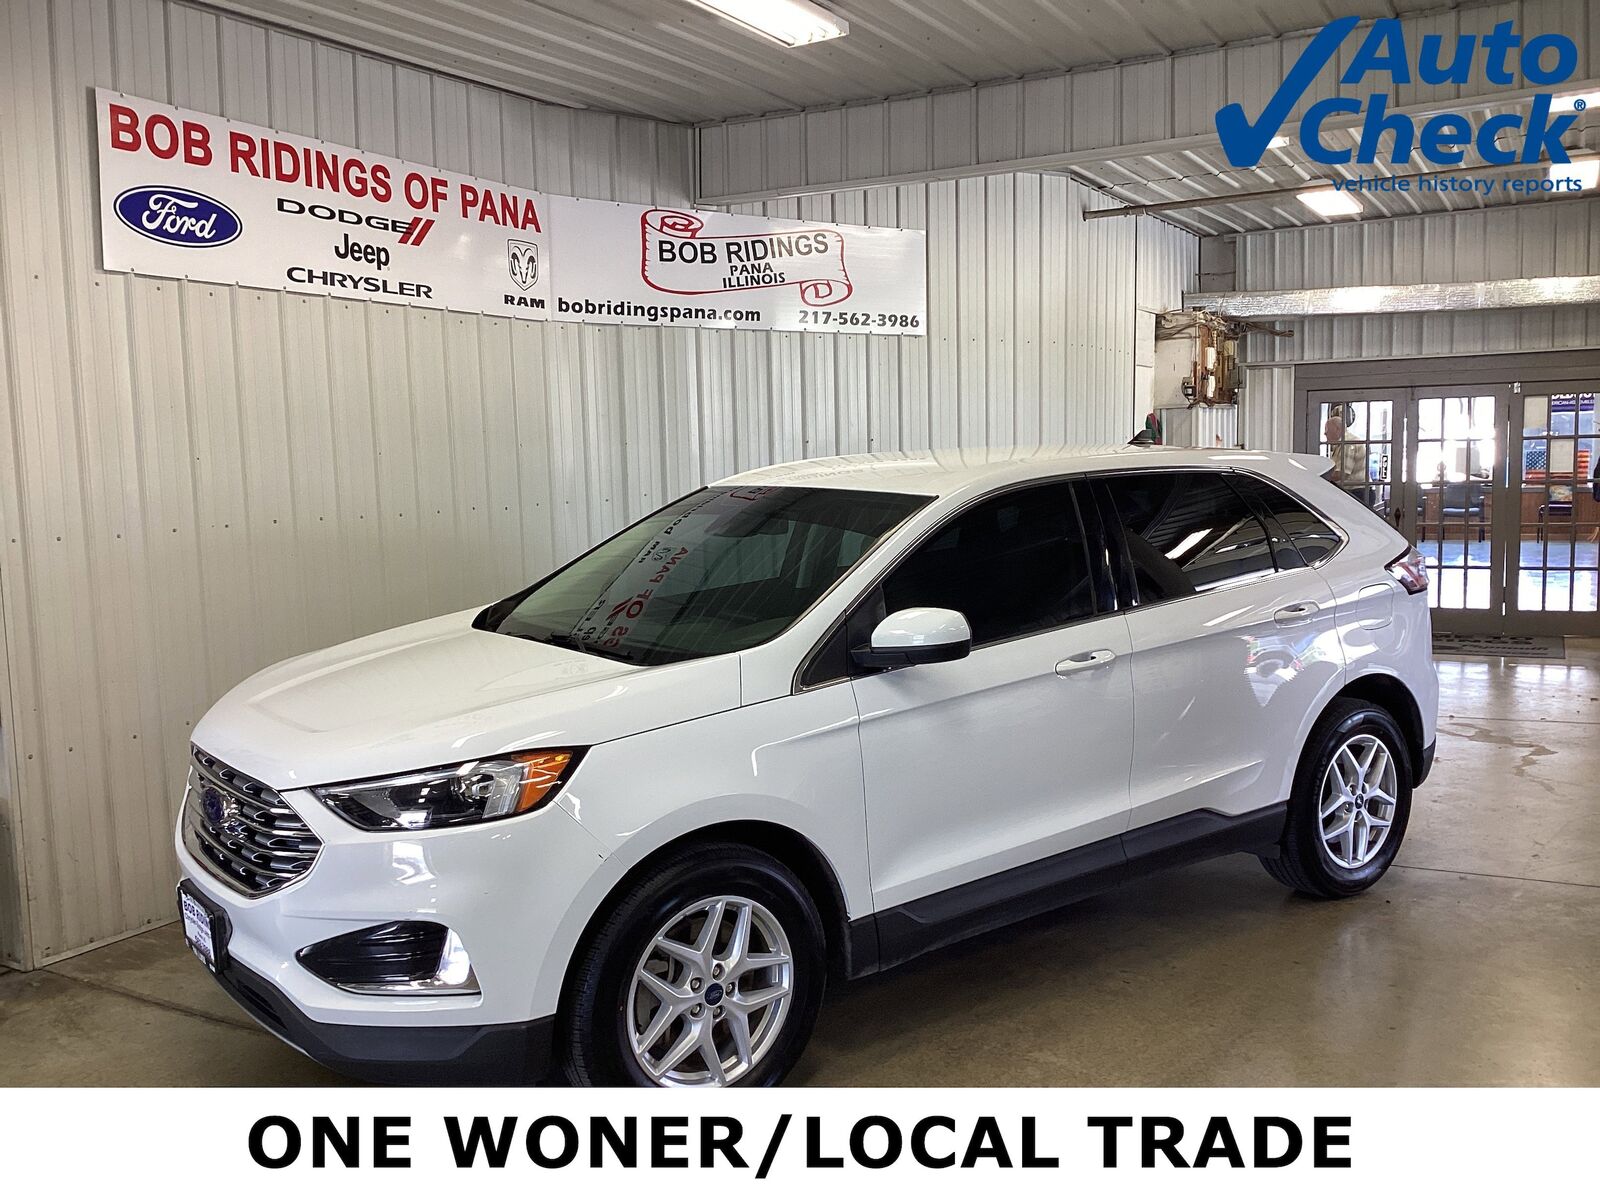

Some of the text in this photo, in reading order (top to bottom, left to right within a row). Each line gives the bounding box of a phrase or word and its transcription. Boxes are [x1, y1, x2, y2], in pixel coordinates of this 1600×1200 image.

[109, 103, 542, 234] BOB RIDINGS OF PANA
[141, 193, 217, 240] Ford
[276, 198, 413, 234] DODGE
[334, 232, 391, 271] Jeep
[658, 232, 829, 264] BOB RIDINGS
[286, 266, 434, 300] CHRYSLER
[722, 272, 786, 289] ILLINOIS
[729, 261, 774, 276] PANA
[503, 293, 546, 310] RAM
[557, 296, 762, 323] bobridingspana.com
[798, 309, 920, 329] 217-562-3986
